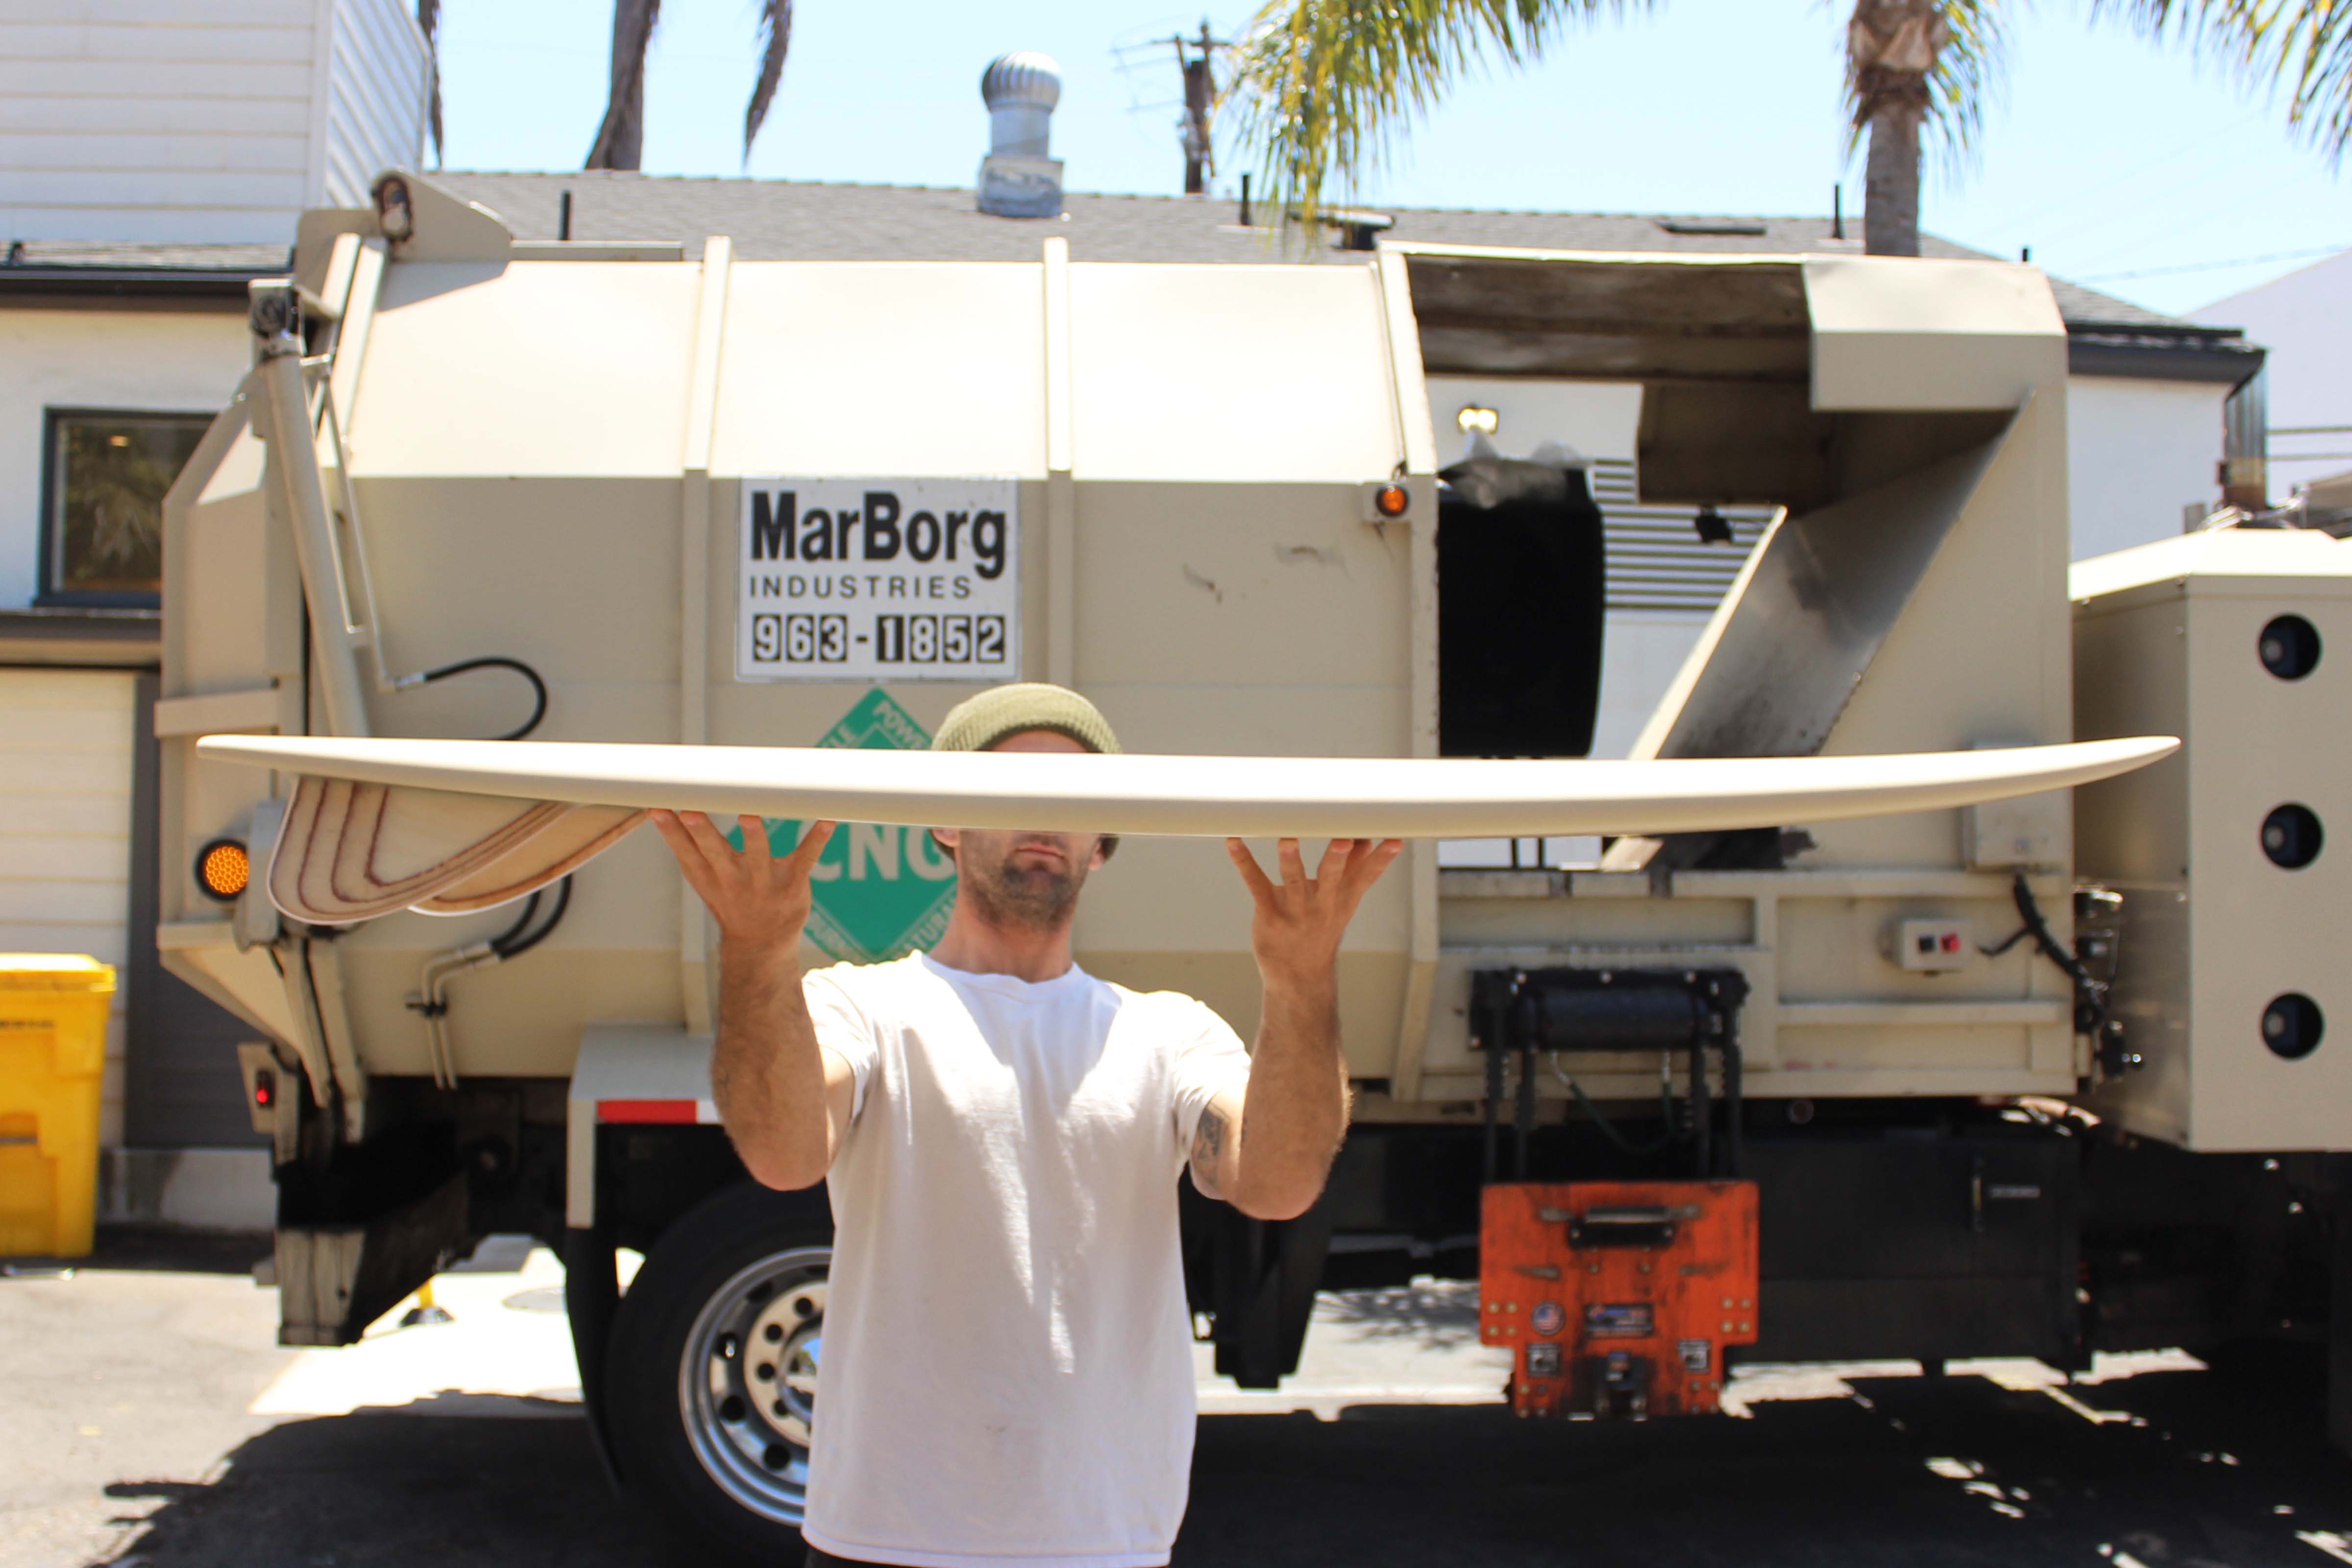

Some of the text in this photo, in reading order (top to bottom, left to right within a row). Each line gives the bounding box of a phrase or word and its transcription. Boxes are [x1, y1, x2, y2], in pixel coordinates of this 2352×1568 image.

[751, 491, 1006, 580] MarBorg
[750, 576, 971, 598] INDUSTRIES
[752, 614, 1005, 662] 963-1852
